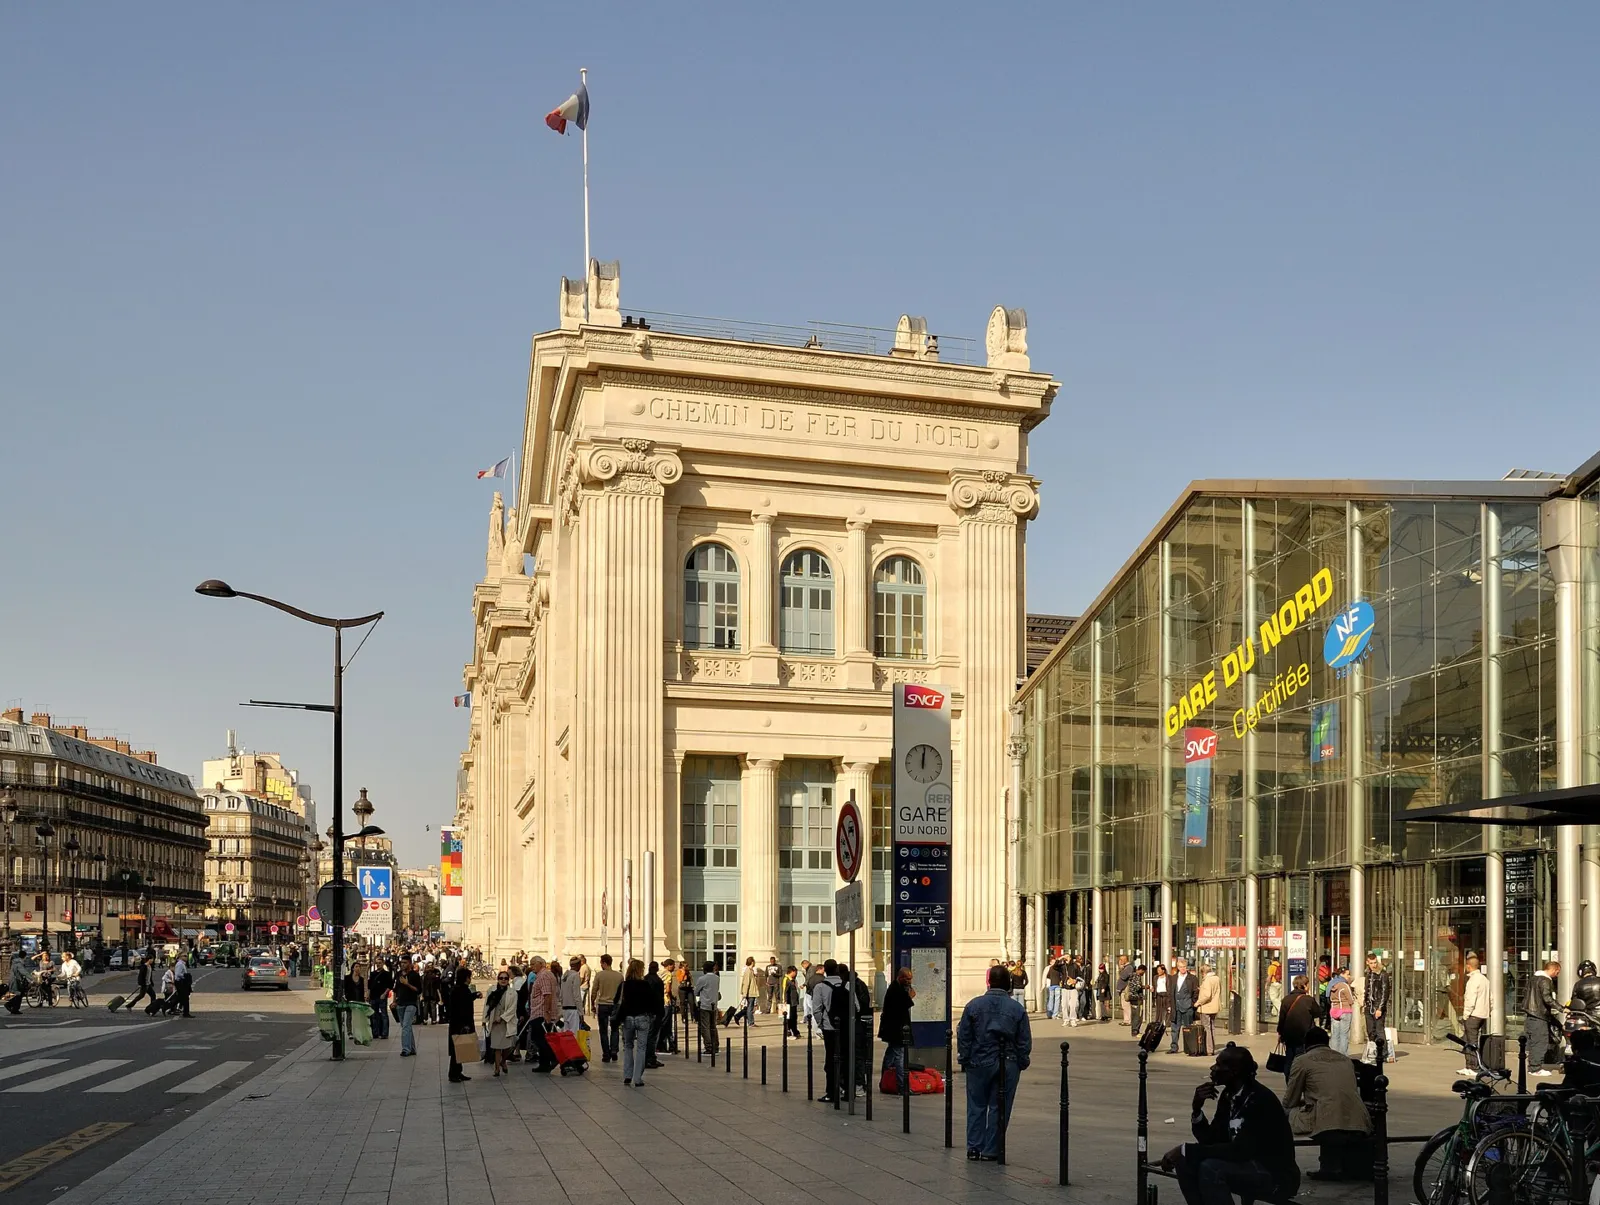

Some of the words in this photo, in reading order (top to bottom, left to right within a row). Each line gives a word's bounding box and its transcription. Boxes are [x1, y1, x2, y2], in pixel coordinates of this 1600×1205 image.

[649, 397, 750, 426] CHEMIN
[760, 408, 795, 432] DE
[807, 413, 859, 438] FER
[870, 419, 903, 442] DU
[915, 423, 981, 449] NORD
[1335, 607, 1360, 642] NF
[1164, 669, 1218, 738] GARE
[1222, 636, 1255, 689] DU
[1259, 567, 1333, 655] NORD
[905, 693, 943, 706] SNCF
[1232, 662, 1310, 739] Certifiée
[1185, 734, 1217, 759] SNCF
[1320, 747, 1334, 757] SNCF
[899, 806, 947, 822] GARE
[899, 825, 914, 835] DU
[917, 825, 947, 835] NORD
[1429, 896, 1450, 906] GARE
[1453, 895, 1465, 905] DU
[1467, 895, 1486, 904] NOR
